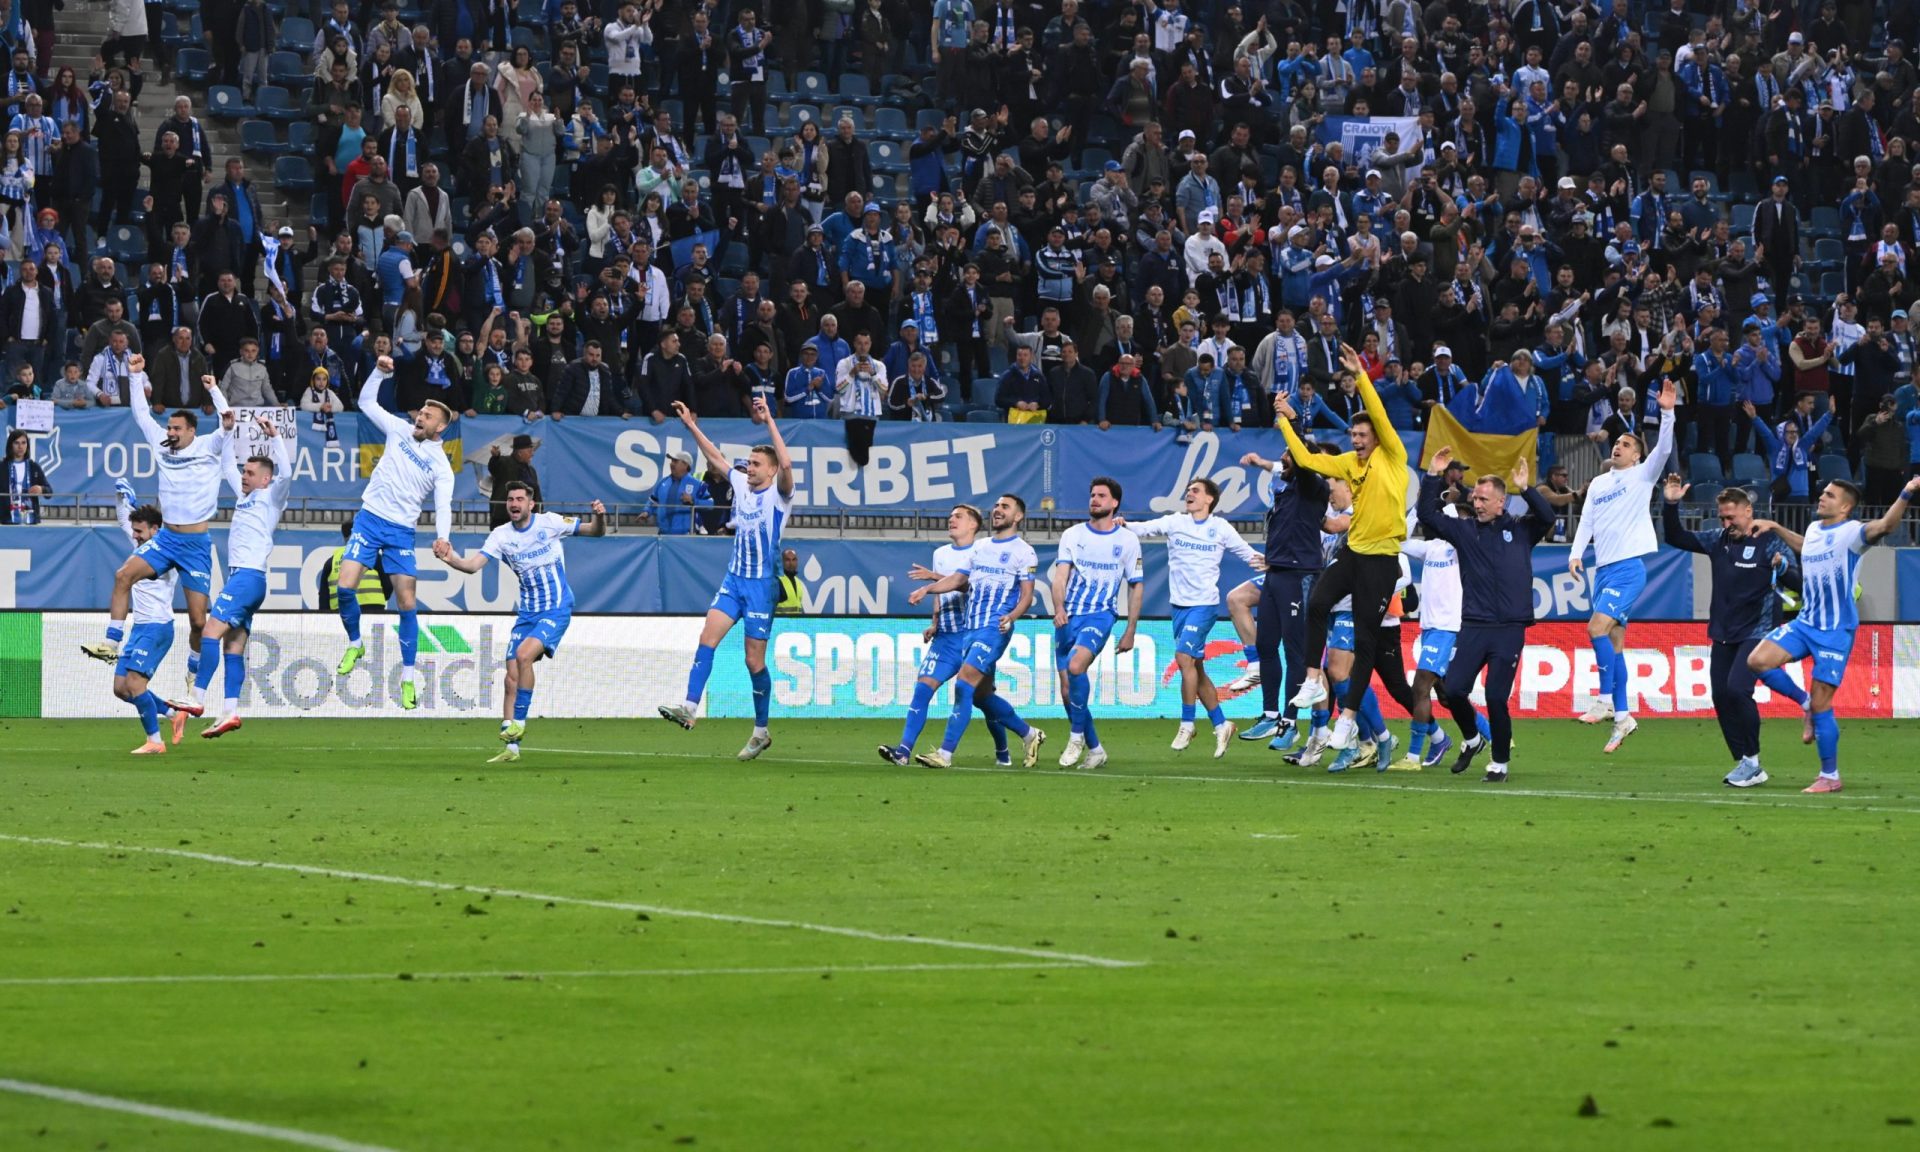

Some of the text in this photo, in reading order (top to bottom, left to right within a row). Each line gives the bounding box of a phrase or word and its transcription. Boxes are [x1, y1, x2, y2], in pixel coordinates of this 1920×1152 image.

[609, 429, 996, 507] SERBET
[1175, 538, 1217, 552] SUPERBET
[1076, 558, 1119, 571] SUPERBET
[920, 660, 936, 675] 29
